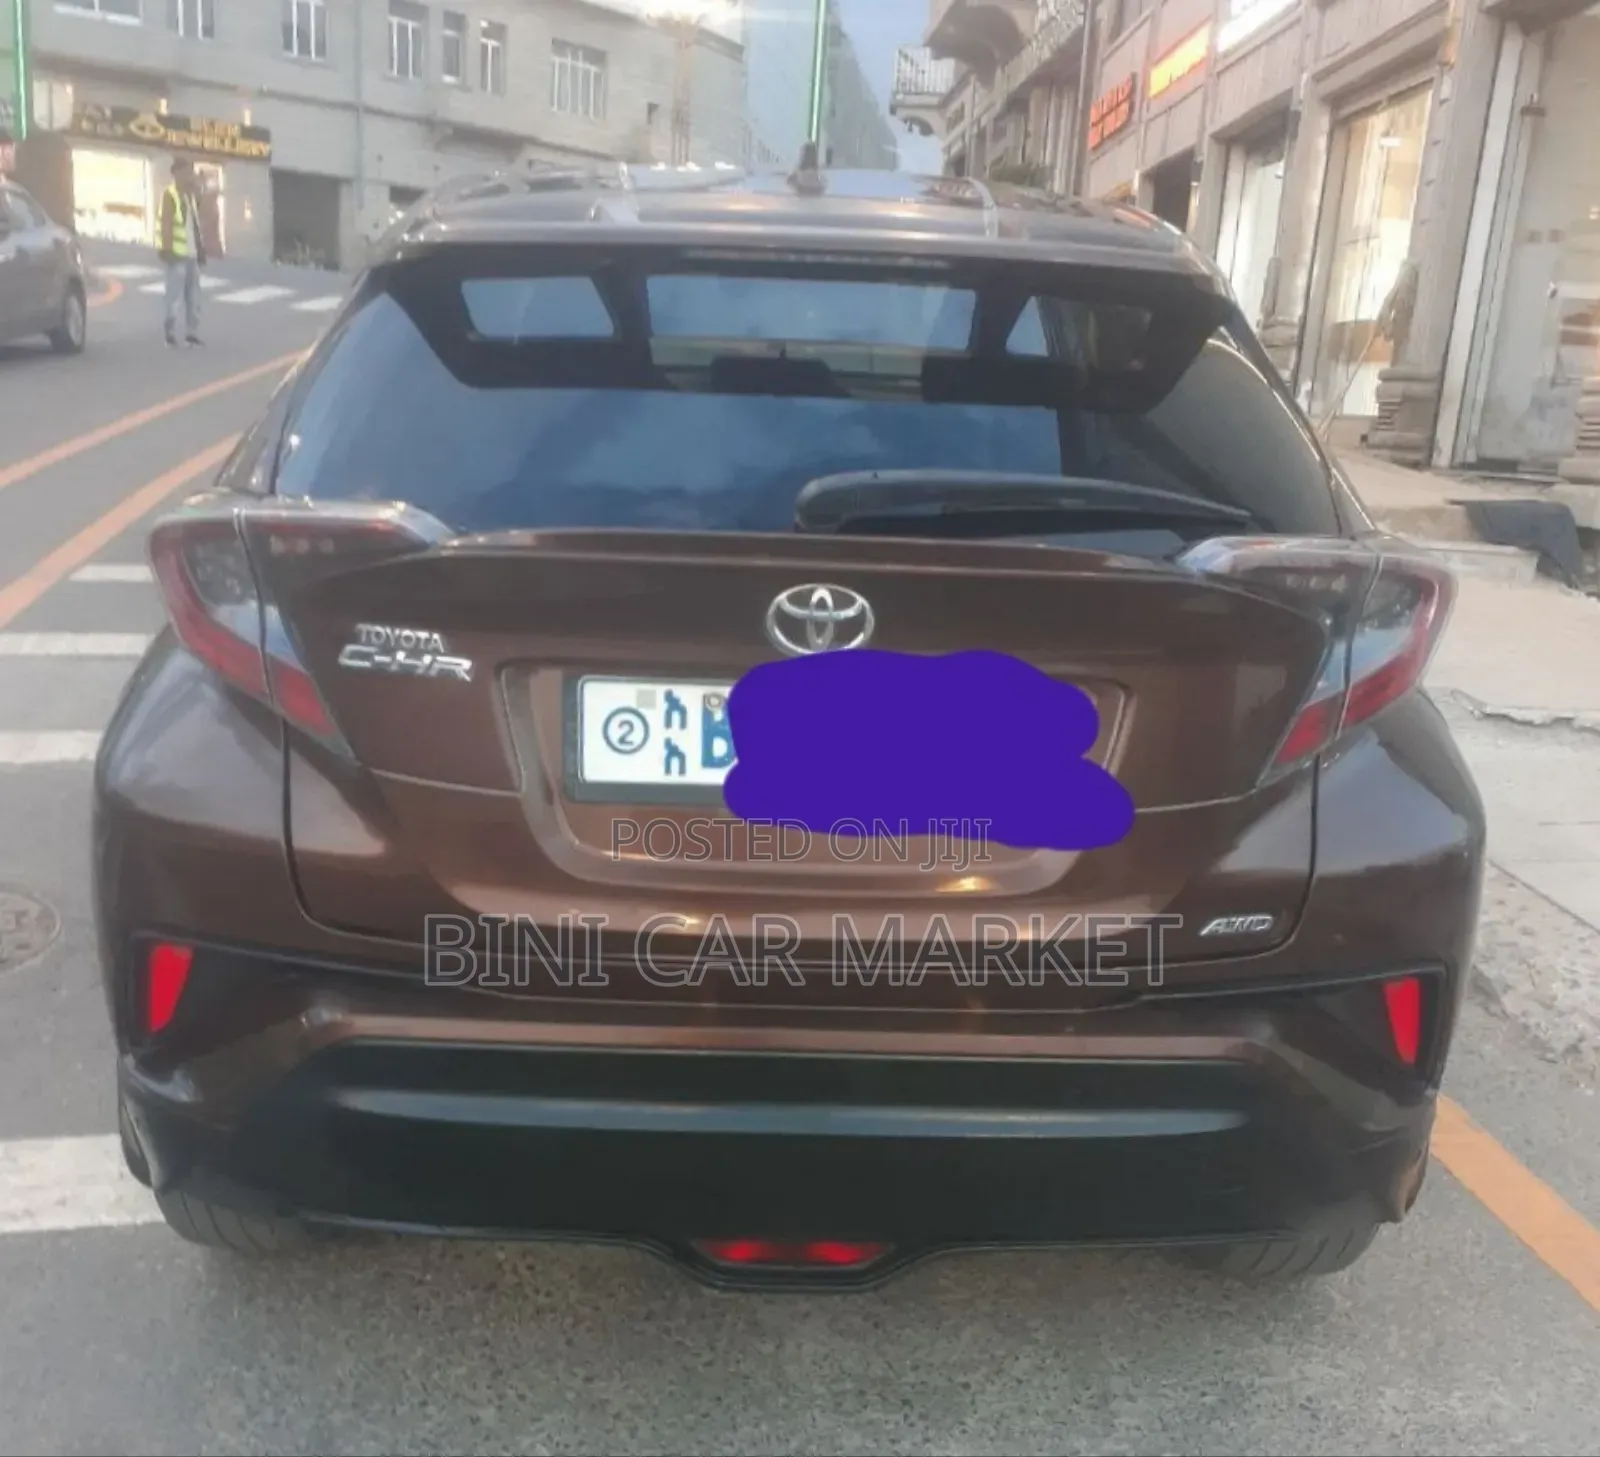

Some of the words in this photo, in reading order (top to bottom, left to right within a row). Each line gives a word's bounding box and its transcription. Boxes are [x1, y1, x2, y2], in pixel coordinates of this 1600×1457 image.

[355, 623, 444, 653] TOYOTA
[337, 644, 473, 682] C-HR
[617, 719, 635, 746] 2
[1199, 914, 1273, 937] AWD
